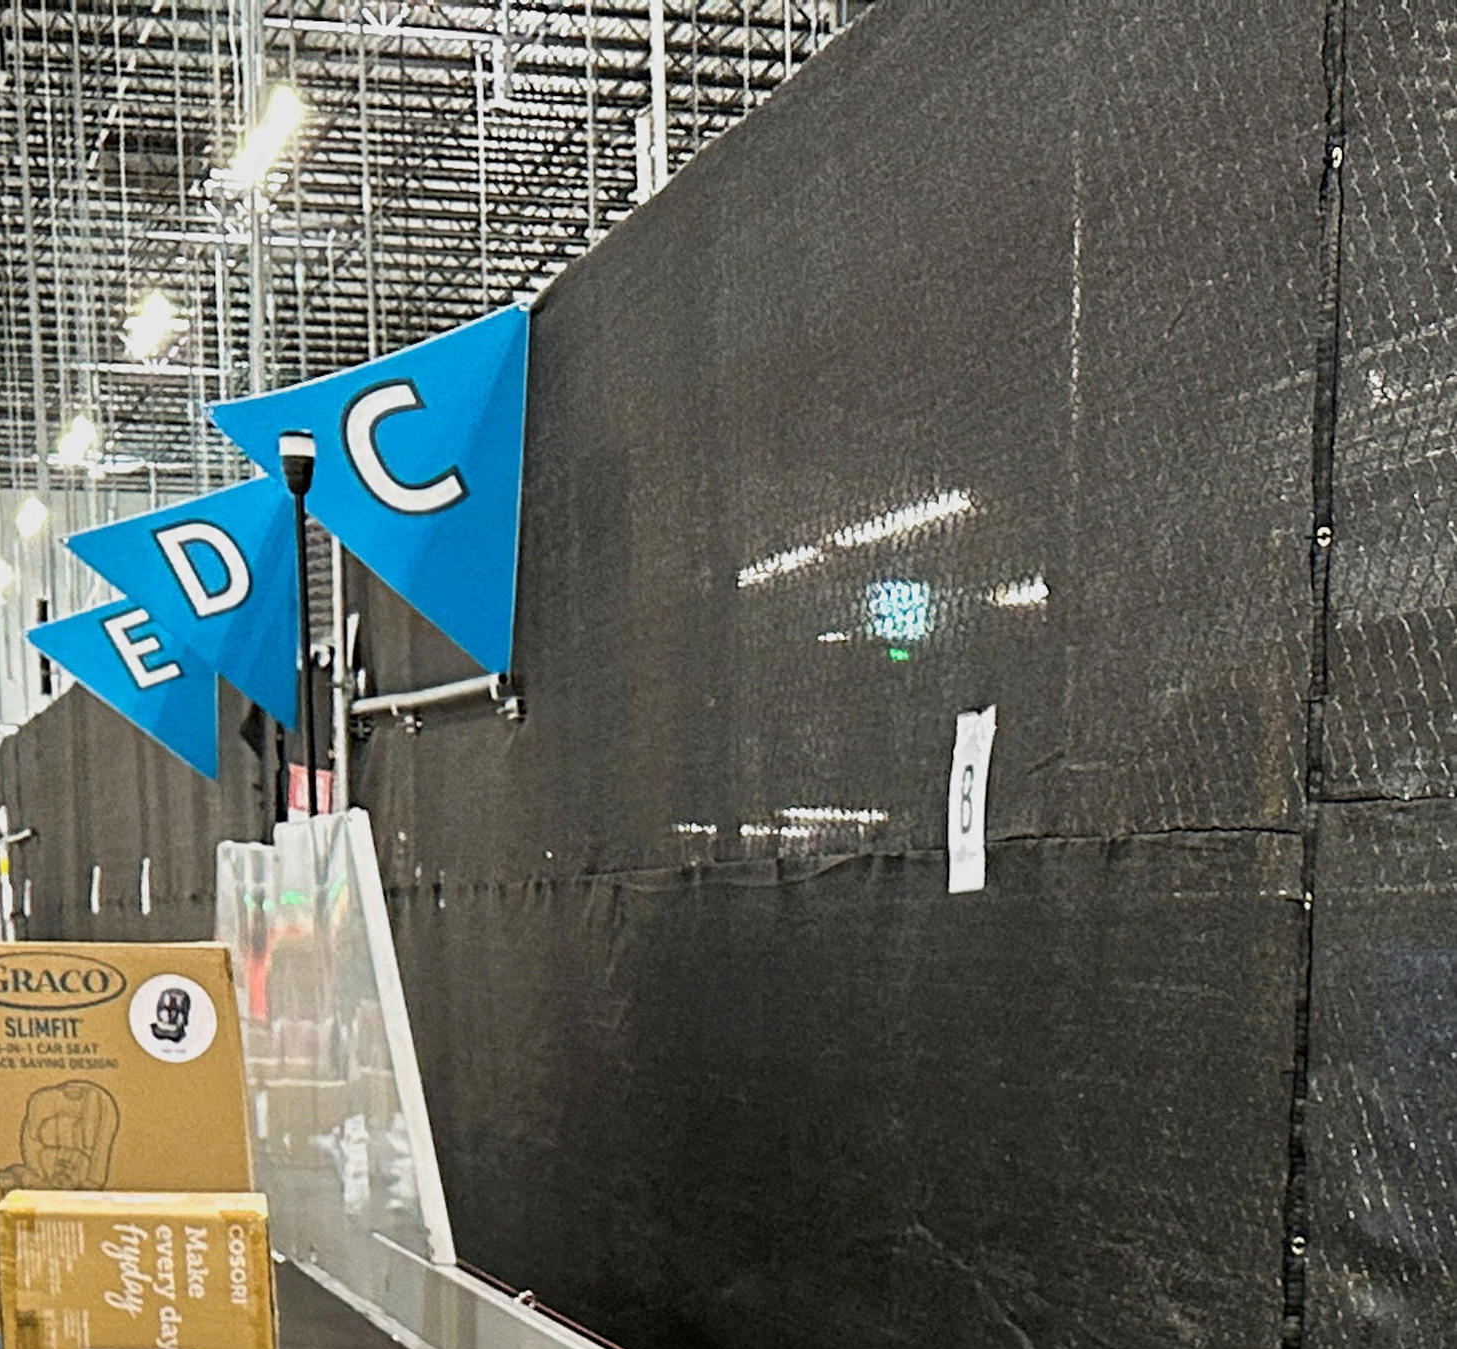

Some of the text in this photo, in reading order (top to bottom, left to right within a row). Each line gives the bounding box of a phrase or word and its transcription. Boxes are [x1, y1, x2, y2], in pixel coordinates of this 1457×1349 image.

[340, 378, 470, 516] C
[151, 520, 253, 620] D
[101, 607, 185, 691] E
[4, 1017, 79, 1040] SLIMFIT
[20, 1057, 67, 1070] SAVING
[36, 1042, 64, 1056] CAR
[65, 1042, 100, 1056] SEAT
[100, 1223, 153, 1319] fryday
[152, 1224, 183, 1349] every day
[184, 1225, 209, 1299] Make
[227, 1224, 248, 1306] COSORI
